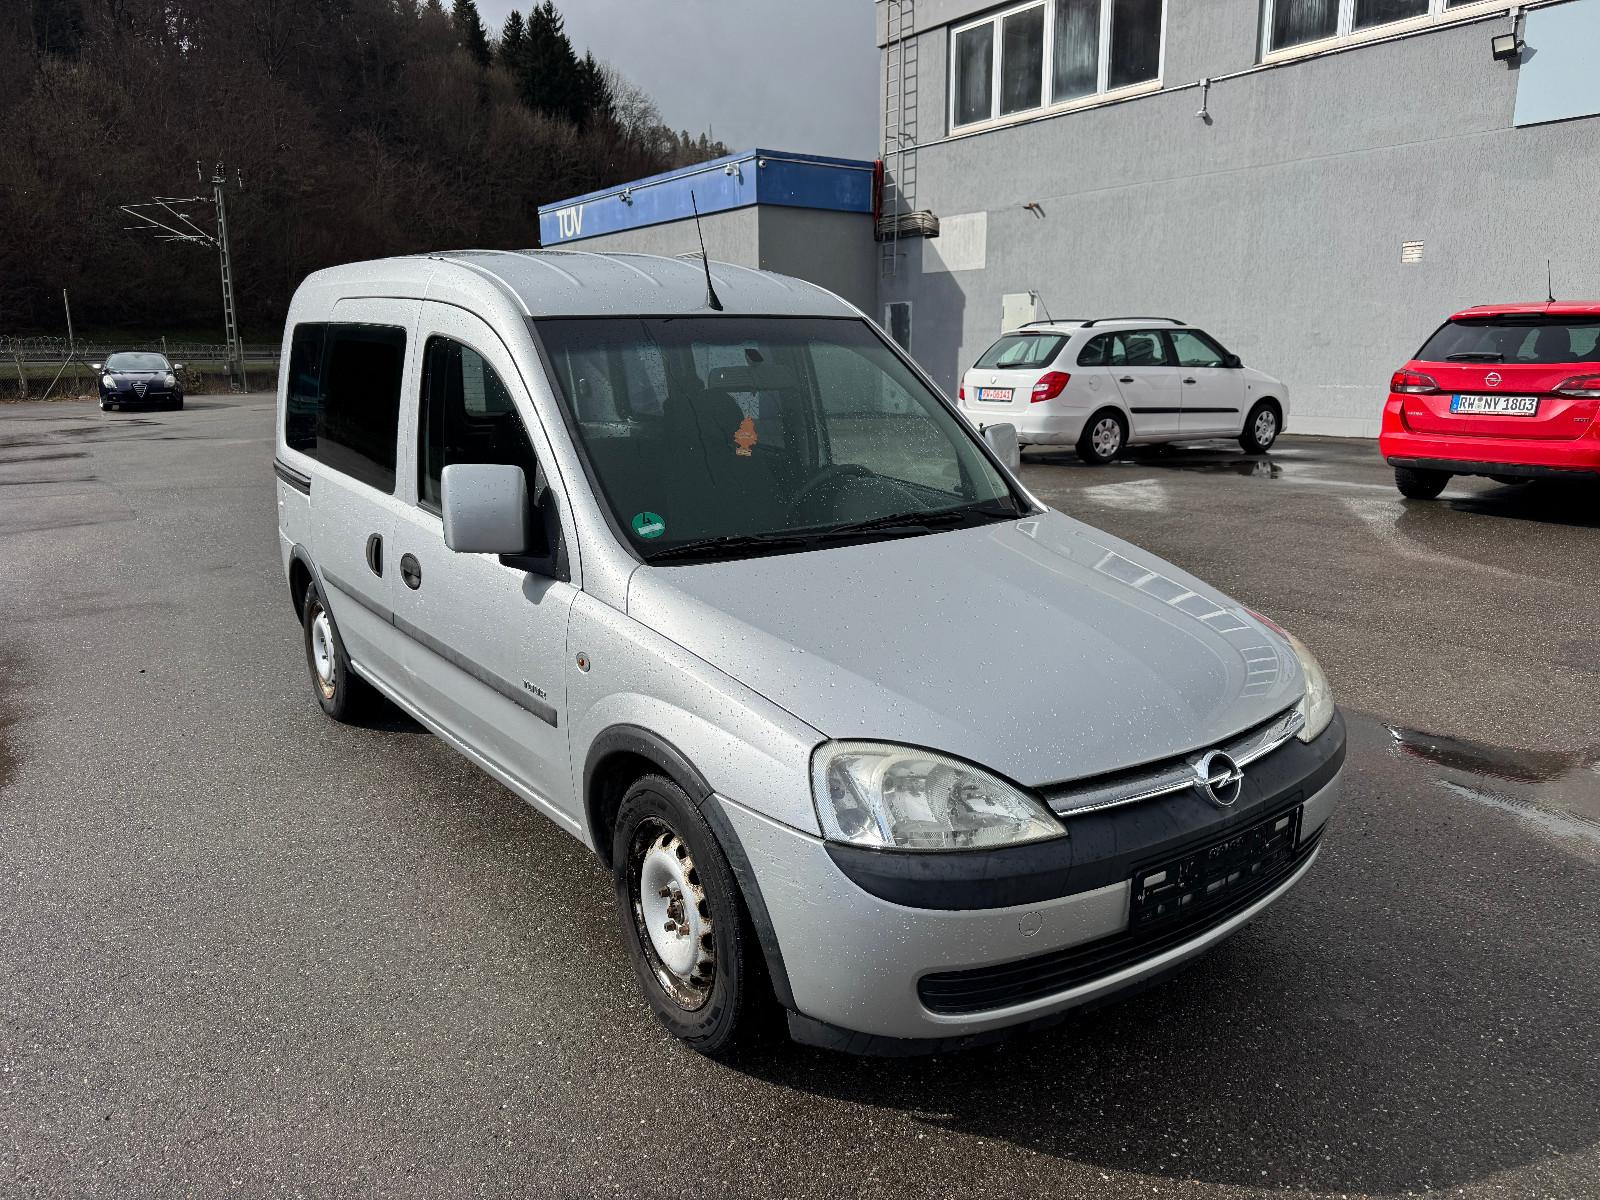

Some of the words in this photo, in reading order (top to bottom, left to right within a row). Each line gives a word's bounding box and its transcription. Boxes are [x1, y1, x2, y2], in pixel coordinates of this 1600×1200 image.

[556, 204, 583, 239] TÜV
[1459, 396, 1476, 409] RW
[1483, 397, 1501, 410] NY
[1502, 398, 1535, 411] 1803
